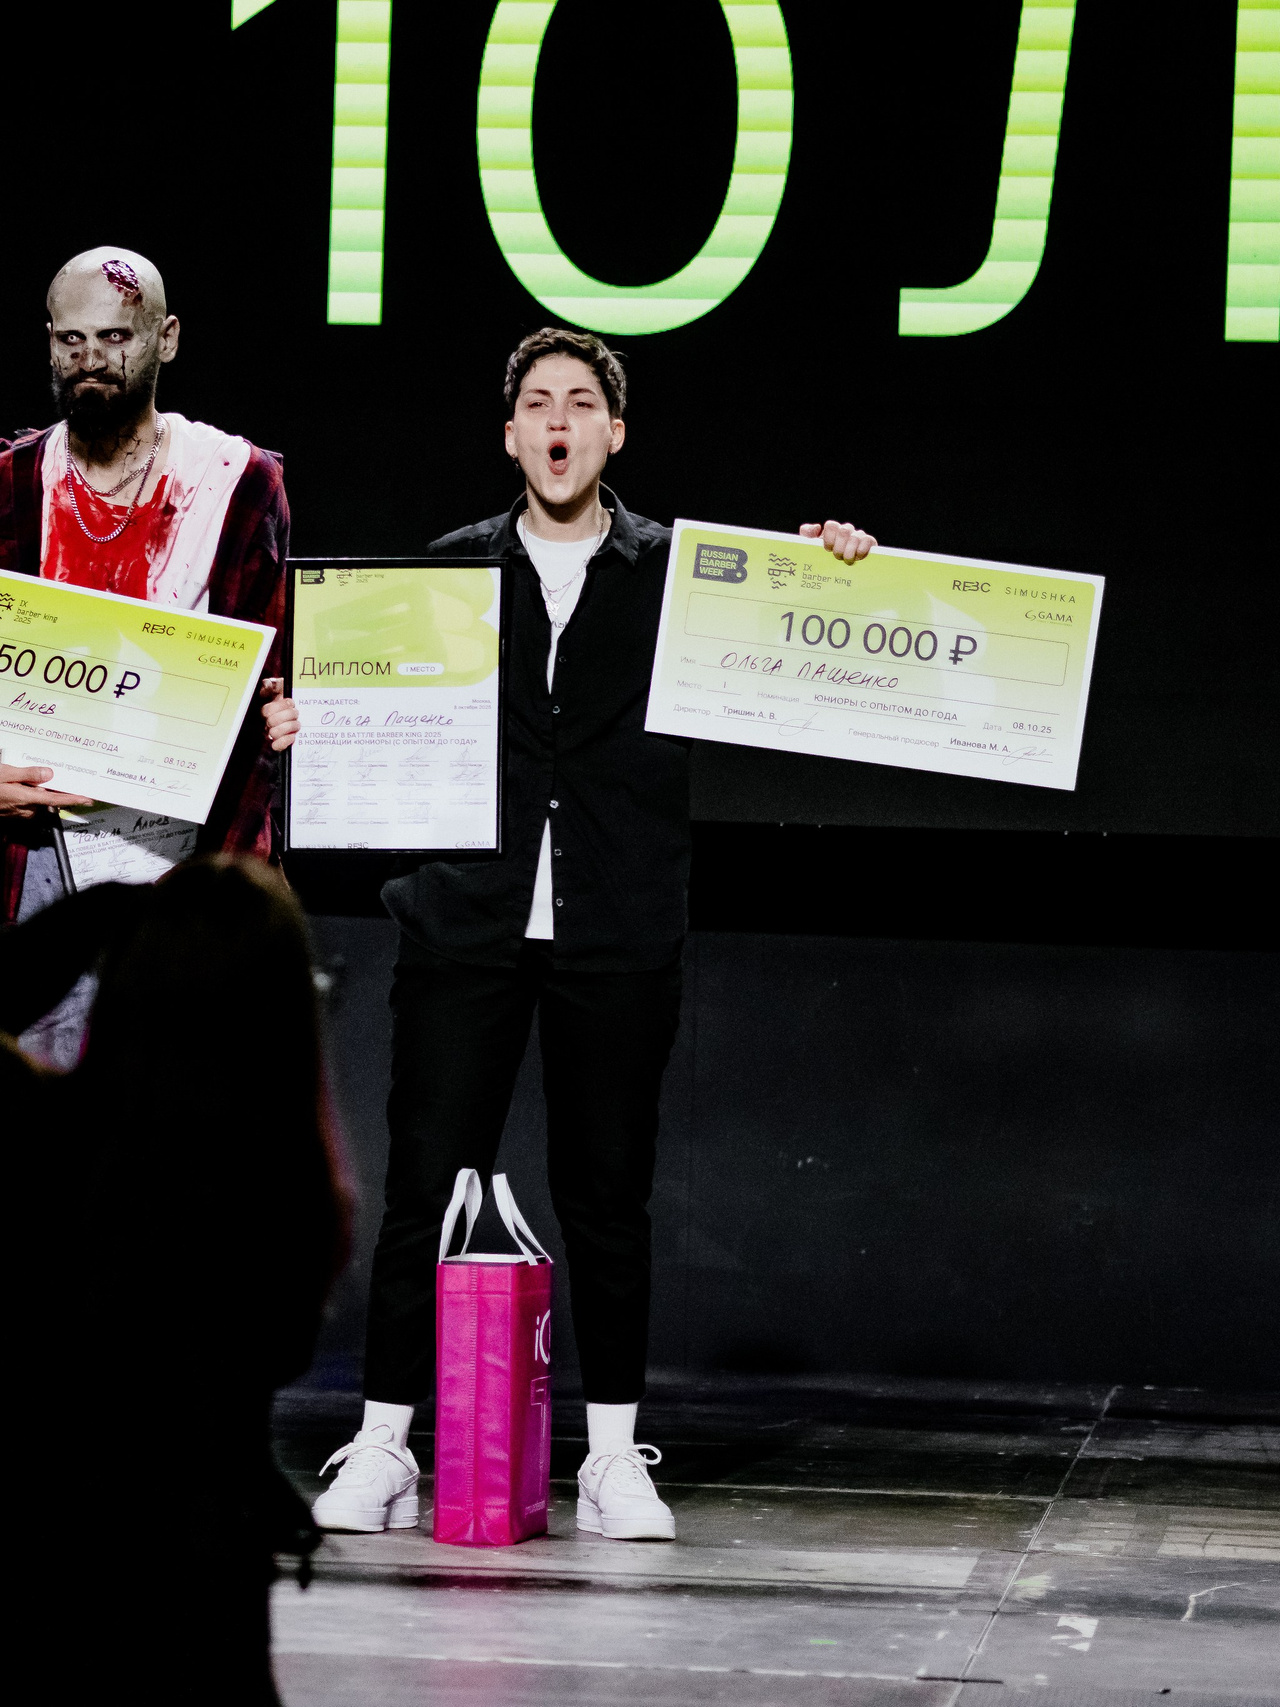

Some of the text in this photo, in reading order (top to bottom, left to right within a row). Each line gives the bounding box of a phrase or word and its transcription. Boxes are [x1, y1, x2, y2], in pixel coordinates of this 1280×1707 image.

[700, 550, 738, 561] RUSSIAN
[700, 558, 736, 570] BARBER
[803, 564, 812, 572] IX
[699, 567, 724, 577] WEEK
[800, 582, 822, 590] 2025
[802, 572, 852, 587] barber king
[1005, 586, 1076, 604] SIMUSHKA
[19, 600, 28, 608] IX
[16, 608, 58, 624] barber king
[186, 631, 246, 651] SIMUSHKA
[780, 611, 851, 649] 100
[863, 623, 938, 661] 000
[680, 656, 696, 665] Имя
[43, 655, 108, 694] 000
[676, 680, 702, 690] Место
[673, 704, 711, 716] Директор
[722, 706, 756, 718] Тришин
[757, 691, 958, 722] Номинация ЮНИОРЫ С ОПЫТОМ ДО ГОДА
[982, 721, 1052, 734] Дата 08.10.25
[0, 719, 37, 734] ЮНИОРЫ
[38, 728, 44, 736] С
[46, 728, 82, 744] ОПЫТОМ
[82, 738, 96, 748] ДО
[97, 740, 120, 753] ГОДА
[310, 732, 339, 740] ПОБЕДУ
[848, 728, 899, 742] Генеральный
[900, 736, 940, 748] продюсер
[950, 738, 987, 750] Иванова
[163, 756, 198, 770] 08.10.25
[106, 767, 138, 781] Иванова
